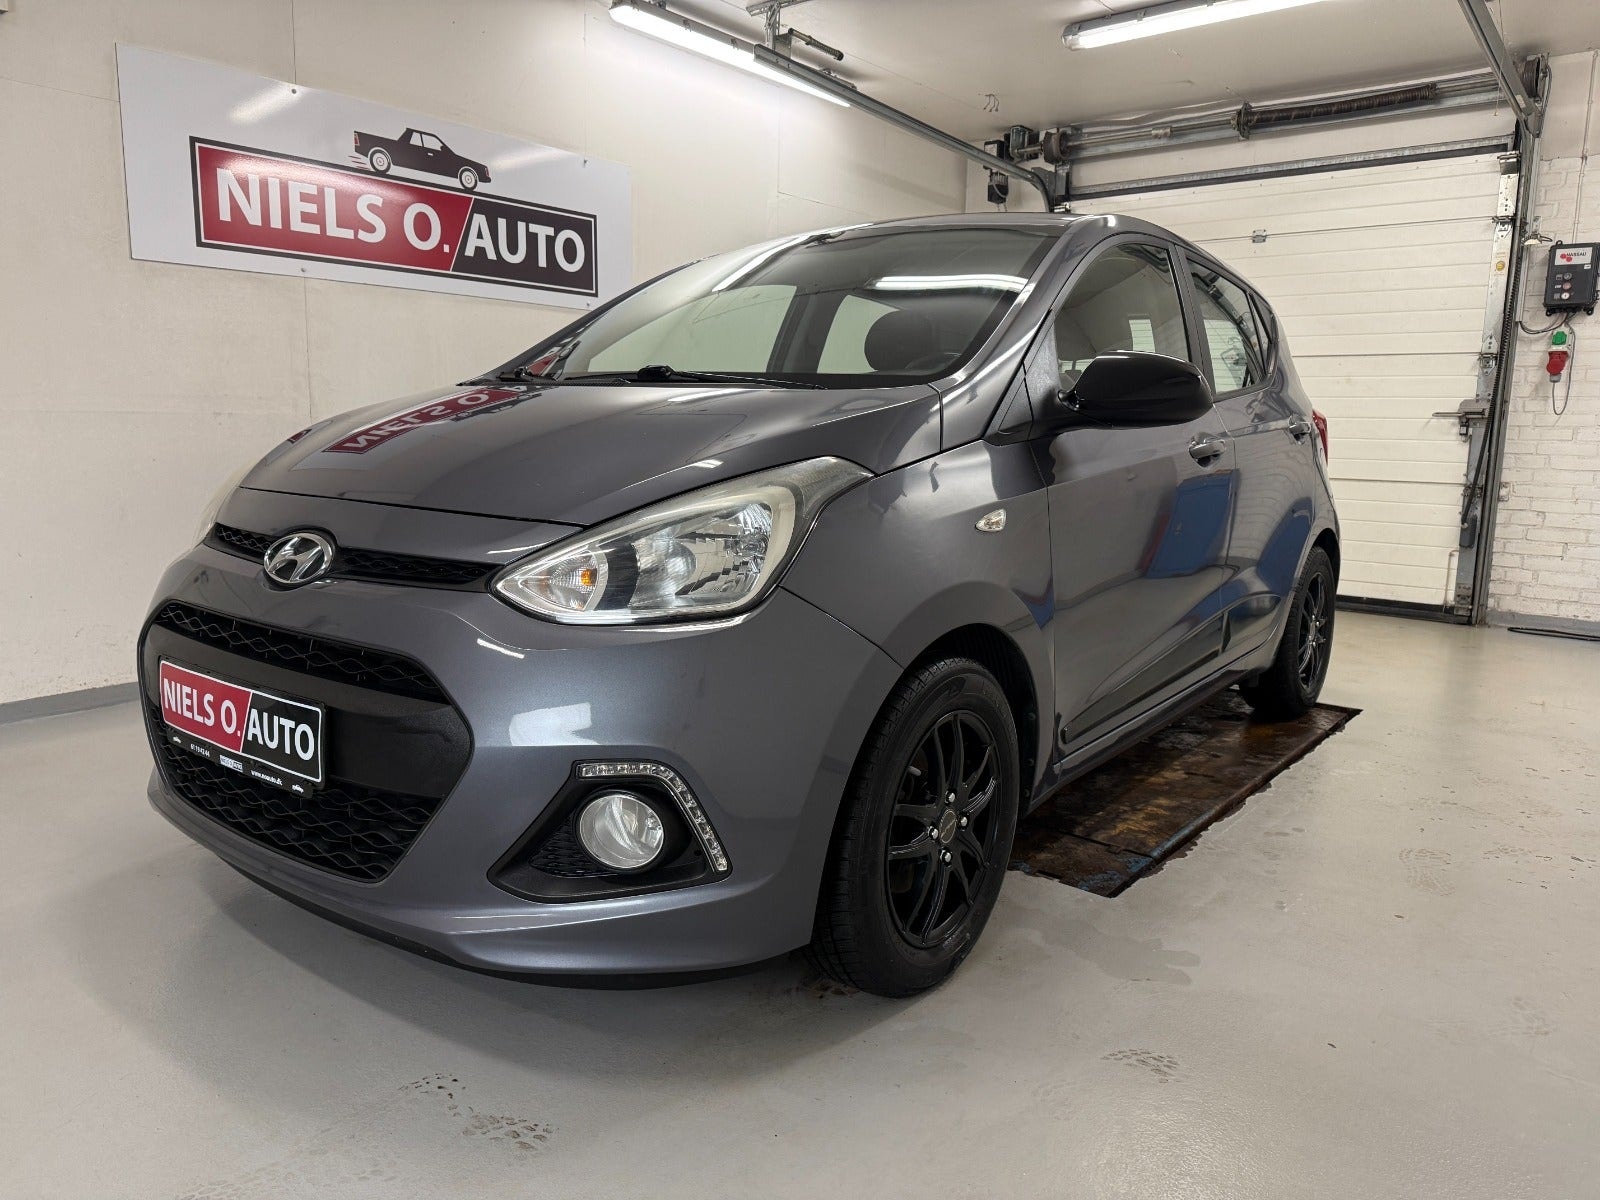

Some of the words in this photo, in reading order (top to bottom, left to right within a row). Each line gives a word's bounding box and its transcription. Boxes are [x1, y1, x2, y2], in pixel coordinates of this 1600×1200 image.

[216, 168, 387, 244] NIELS
[403, 202, 451, 253] O.
[464, 213, 586, 273] AUTO
[163, 678, 215, 727] NIELS
[220, 699, 241, 737] O.
[247, 708, 315, 761] AUTO
